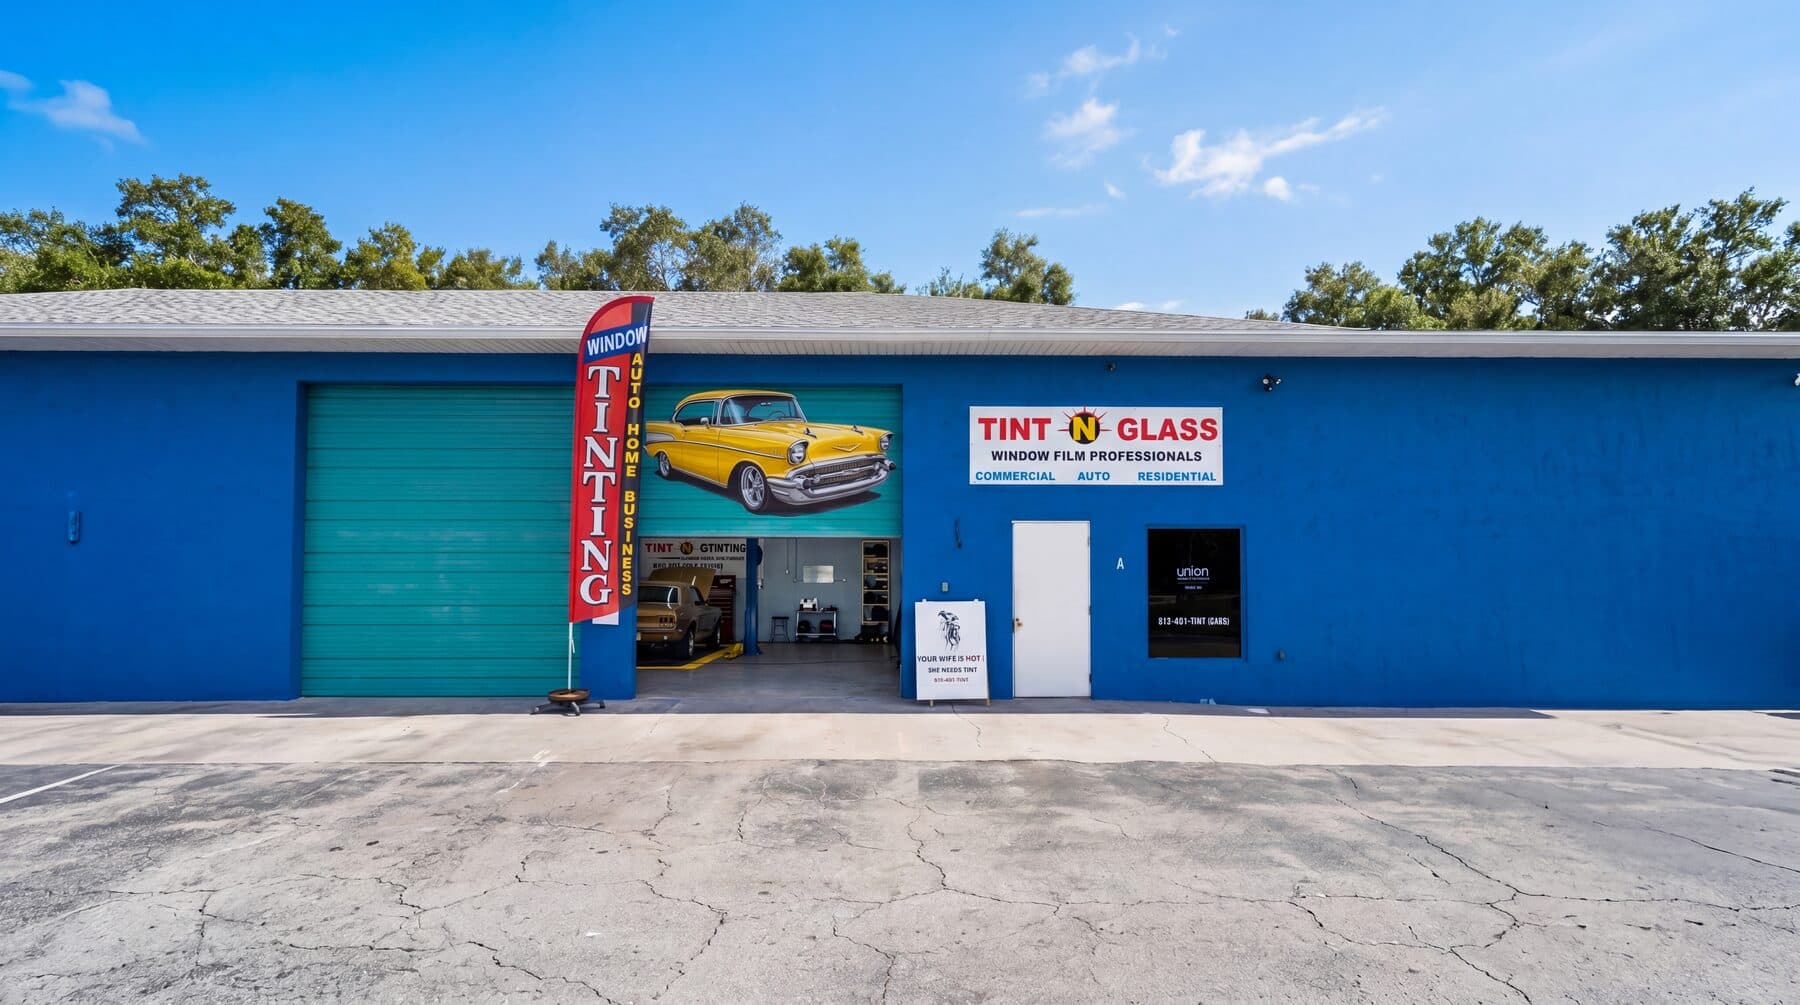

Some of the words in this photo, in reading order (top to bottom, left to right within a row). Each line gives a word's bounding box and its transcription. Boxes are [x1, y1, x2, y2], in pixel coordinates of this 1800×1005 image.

[587, 326, 648, 356] WINDOW
[628, 353, 643, 408] AUTO
[978, 418, 1051, 440] TINT
[1073, 417, 1096, 441] N
[1117, 418, 1218, 441] GLASS
[625, 423, 639, 477] HOME
[991, 451, 1049, 461] WINDOW
[1054, 451, 1085, 461] FILM
[1090, 451, 1202, 462] PROFESSIONALS
[580, 366, 621, 605] TINTING
[975, 472, 1055, 481] COMMERCIAL
[1078, 472, 1110, 481] AUTO
[1138, 472, 1216, 481] RESIDENTIAL
[622, 491, 636, 595] BUSINESS
[645, 543, 673, 552] TINT
[1116, 557, 1124, 569] A
[1177, 565, 1209, 576] union
[1158, 617, 1206, 625] 813-401-TINT
